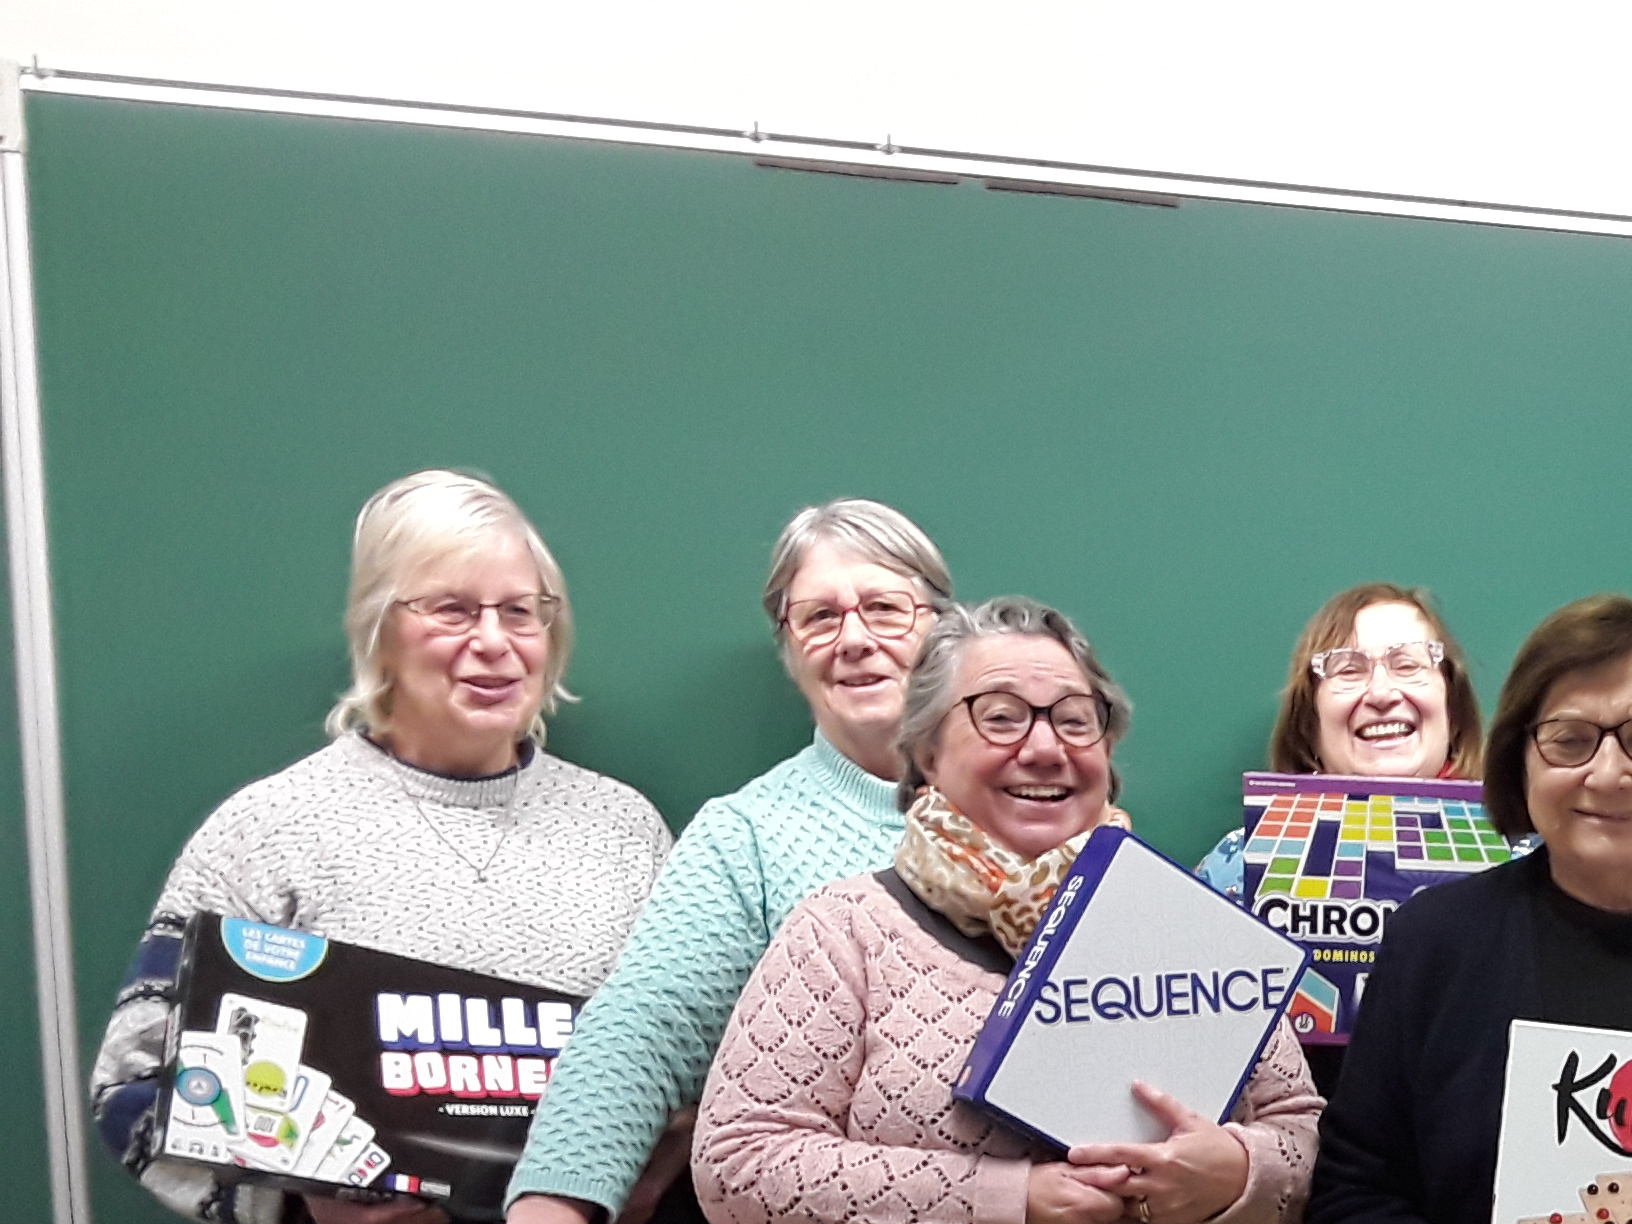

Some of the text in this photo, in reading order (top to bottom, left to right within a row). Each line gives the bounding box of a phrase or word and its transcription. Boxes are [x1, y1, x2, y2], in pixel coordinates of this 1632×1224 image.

[998, 873, 1085, 1018] SEQUENCE
[1313, 949, 1376, 963] DOMINOS
[1034, 966, 1290, 1025] SEQUENCE
[375, 992, 573, 1052] MILLE
[380, 1050, 560, 1096] BORNE
[445, 1103, 530, 1118] VERSION LUXE
